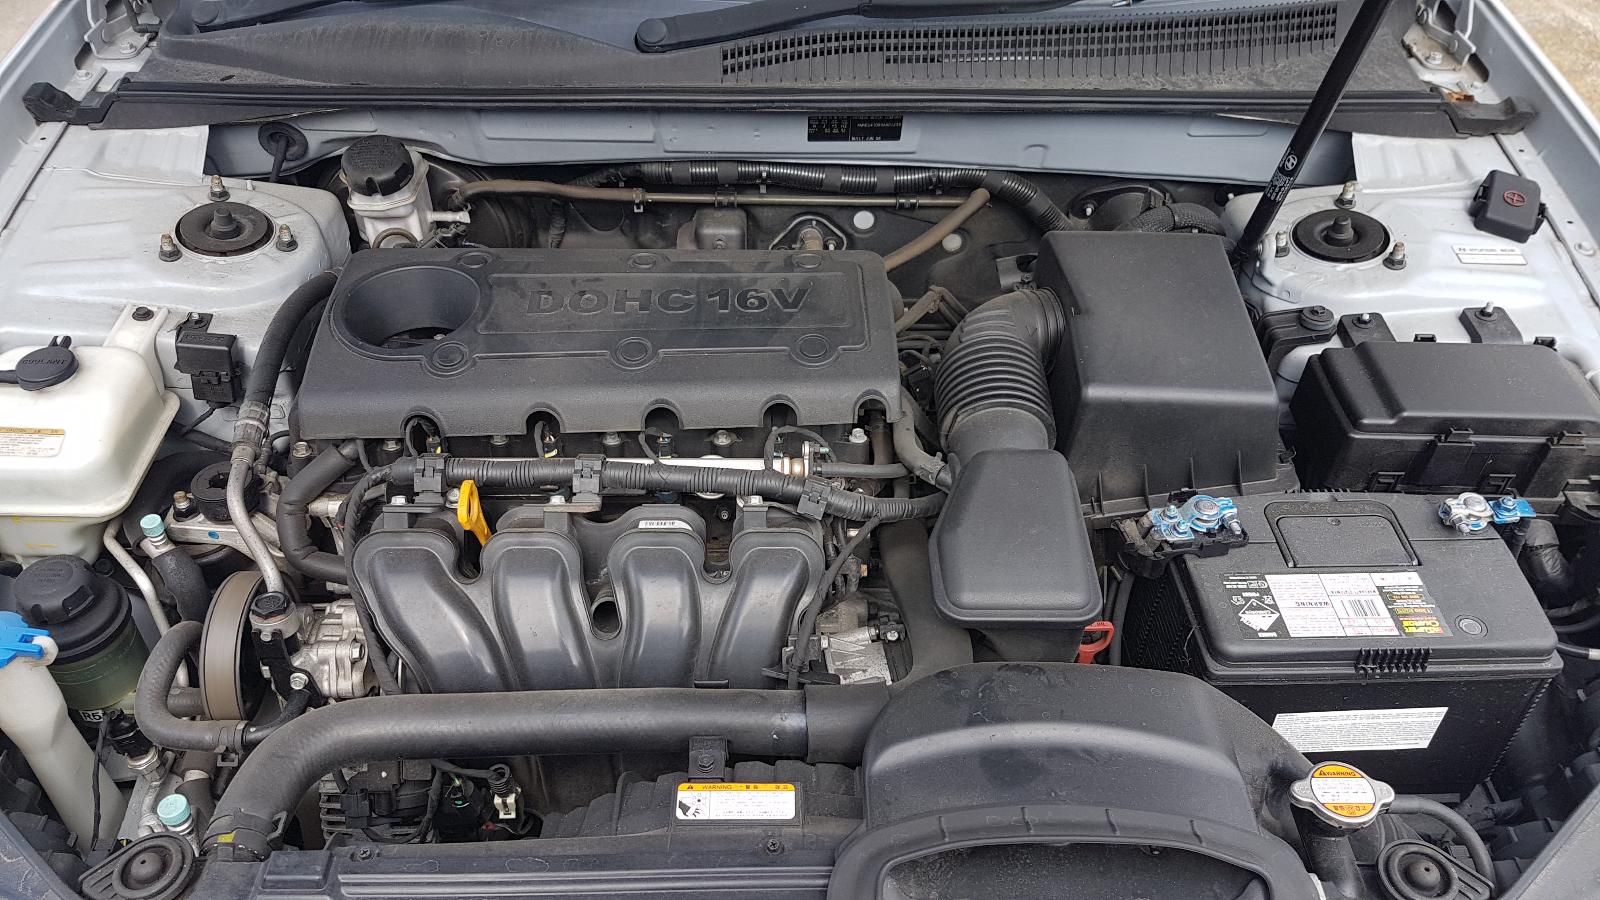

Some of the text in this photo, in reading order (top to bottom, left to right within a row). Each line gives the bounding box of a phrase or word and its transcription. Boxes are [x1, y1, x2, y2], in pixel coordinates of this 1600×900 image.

[526, 287, 813, 315] DOHC 16V
[82, 711, 102, 722] R5
